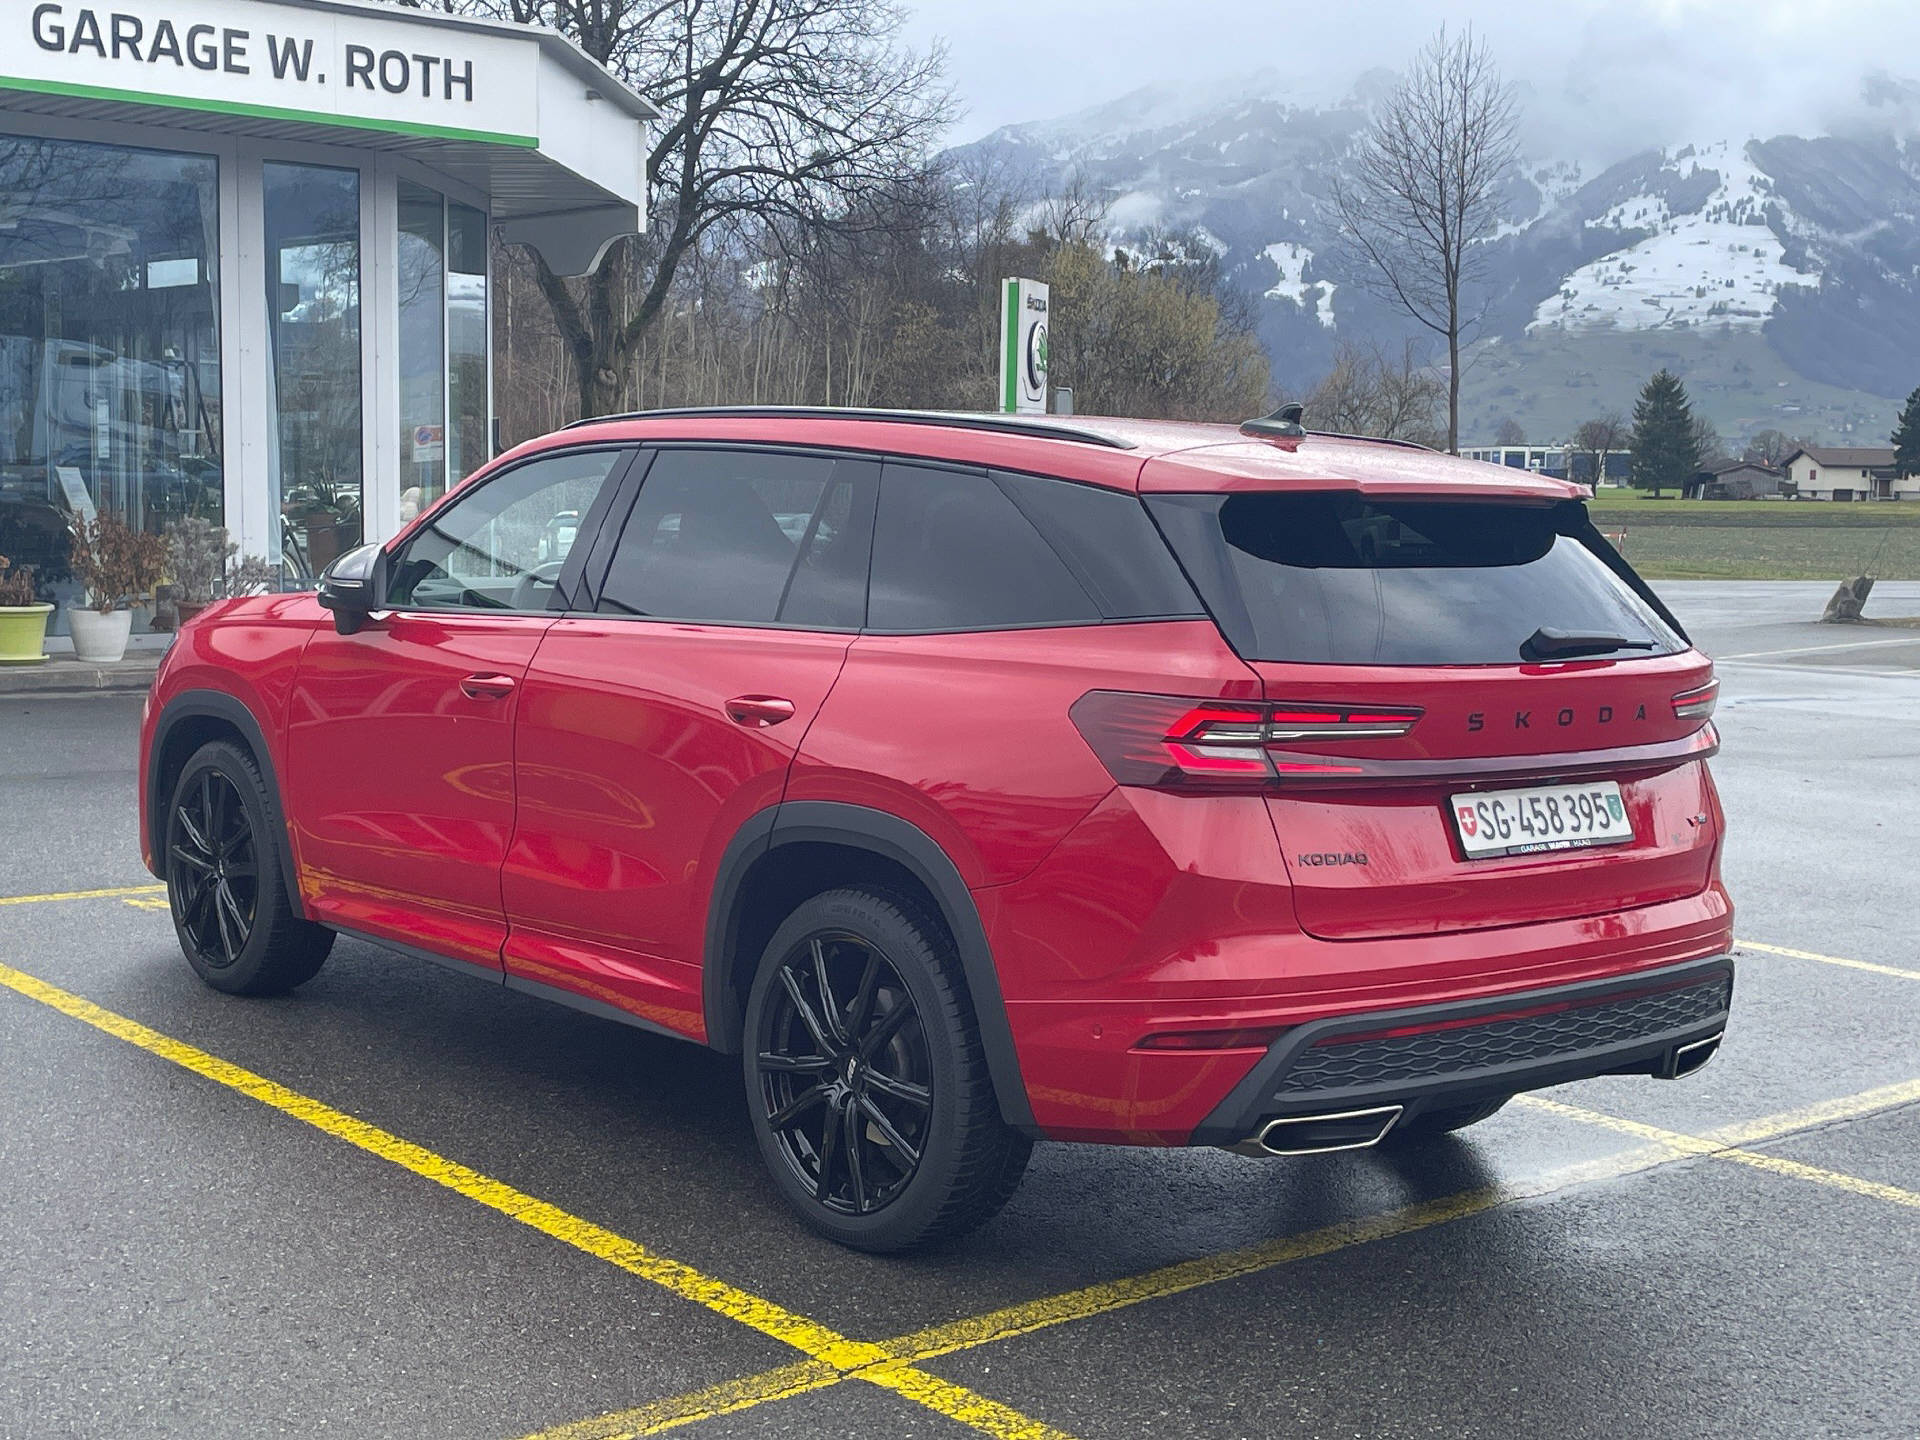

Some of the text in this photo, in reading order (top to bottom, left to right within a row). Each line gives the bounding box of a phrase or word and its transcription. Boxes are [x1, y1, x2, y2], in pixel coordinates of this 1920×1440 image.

[32, 3, 473, 102] GARAGE W. ROTH
[1468, 705, 1646, 731] SKODA
[1298, 852, 1368, 867] KODIAQ
